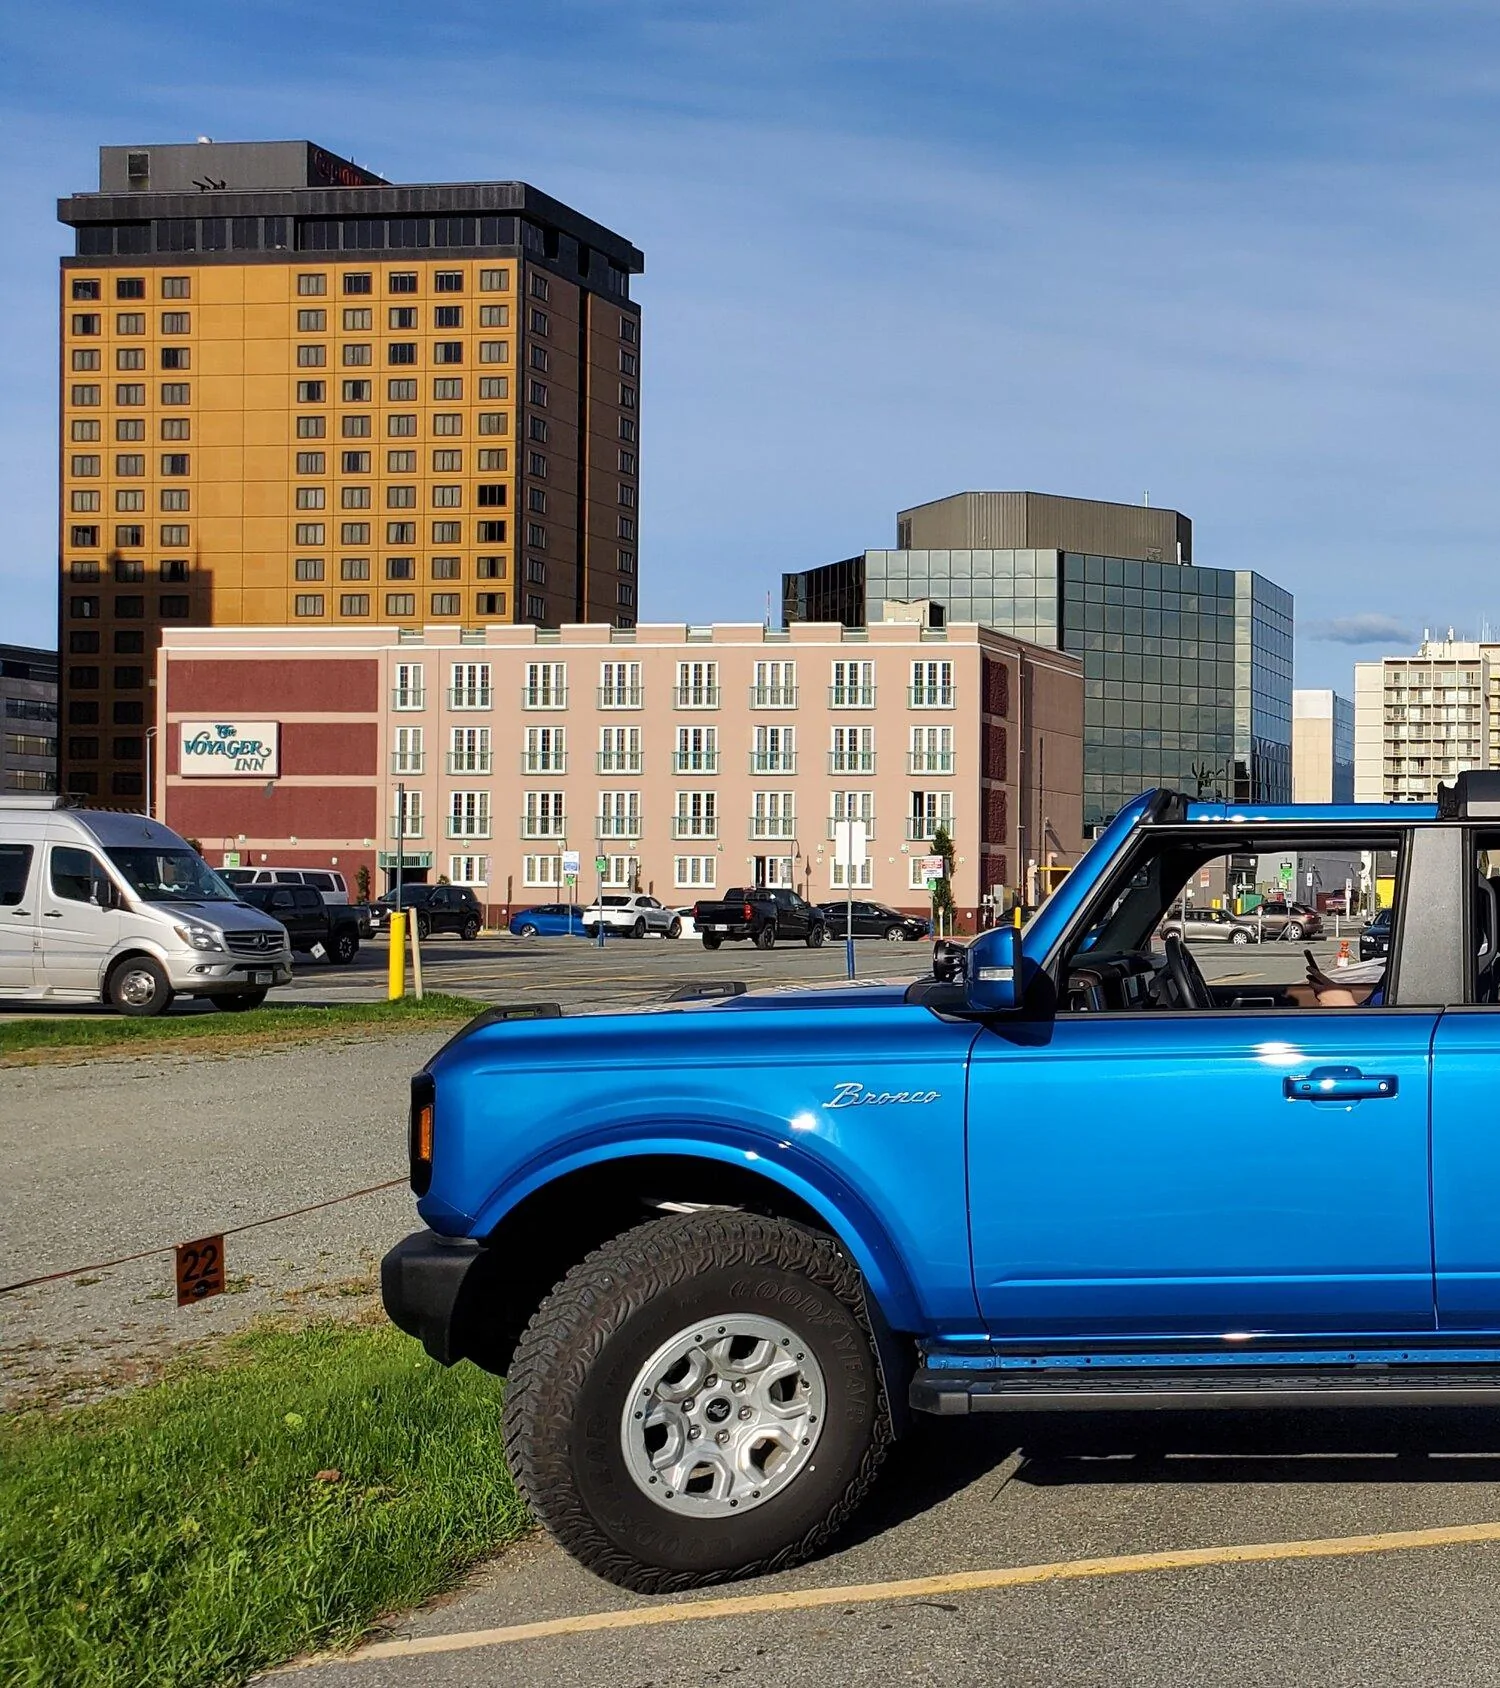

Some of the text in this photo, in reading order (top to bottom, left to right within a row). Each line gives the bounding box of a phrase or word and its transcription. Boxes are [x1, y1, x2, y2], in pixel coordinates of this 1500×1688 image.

[184, 731, 273, 759] VOYAGER
[215, 724, 237, 739] The
[234, 758, 267, 771] INN
[822, 1082, 942, 1109] Bronco
[181, 1244, 219, 1283] 22
[728, 1278, 869, 1425] GOODYEAR
